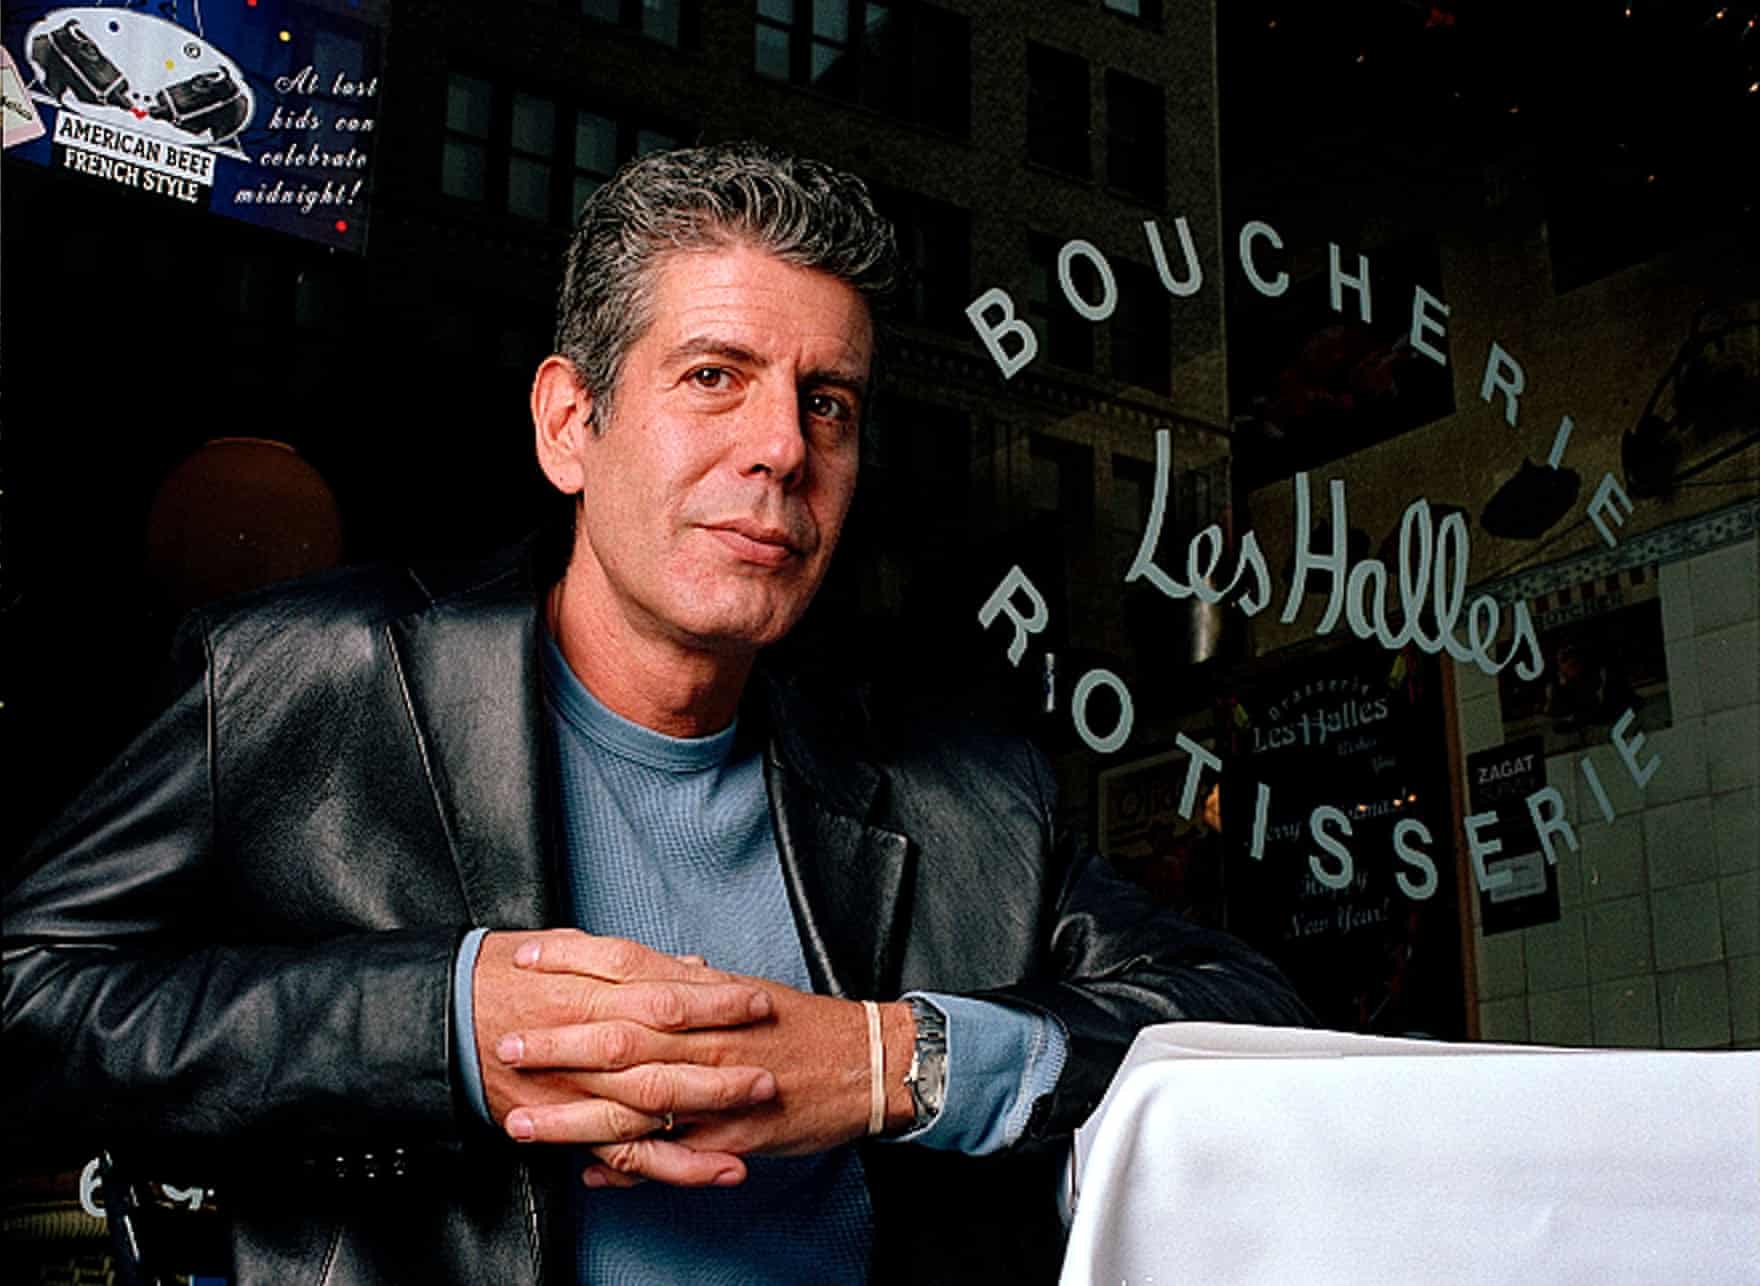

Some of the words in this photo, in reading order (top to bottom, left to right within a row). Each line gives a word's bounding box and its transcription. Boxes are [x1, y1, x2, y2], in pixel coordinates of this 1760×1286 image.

[274, 65, 319, 94] At
[268, 106, 320, 130] kids
[58, 116, 162, 163] AMERICAN
[166, 145, 212, 177] BEEF
[259, 143, 368, 168] celebrate
[63, 148, 140, 187] FRENCH
[143, 170, 199, 203] STYLE
[233, 179, 363, 214] midnight!
[964, 216, 1635, 548] BOUCHERIE
[1124, 428, 1272, 618] Les
[1281, 471, 1544, 681] Halles
[977, 564, 1662, 900] ROTISSERIE
[1252, 725, 1298, 754] Les
[1296, 697, 1390, 746] Halles
[1476, 753, 1536, 785] ZAGAT
